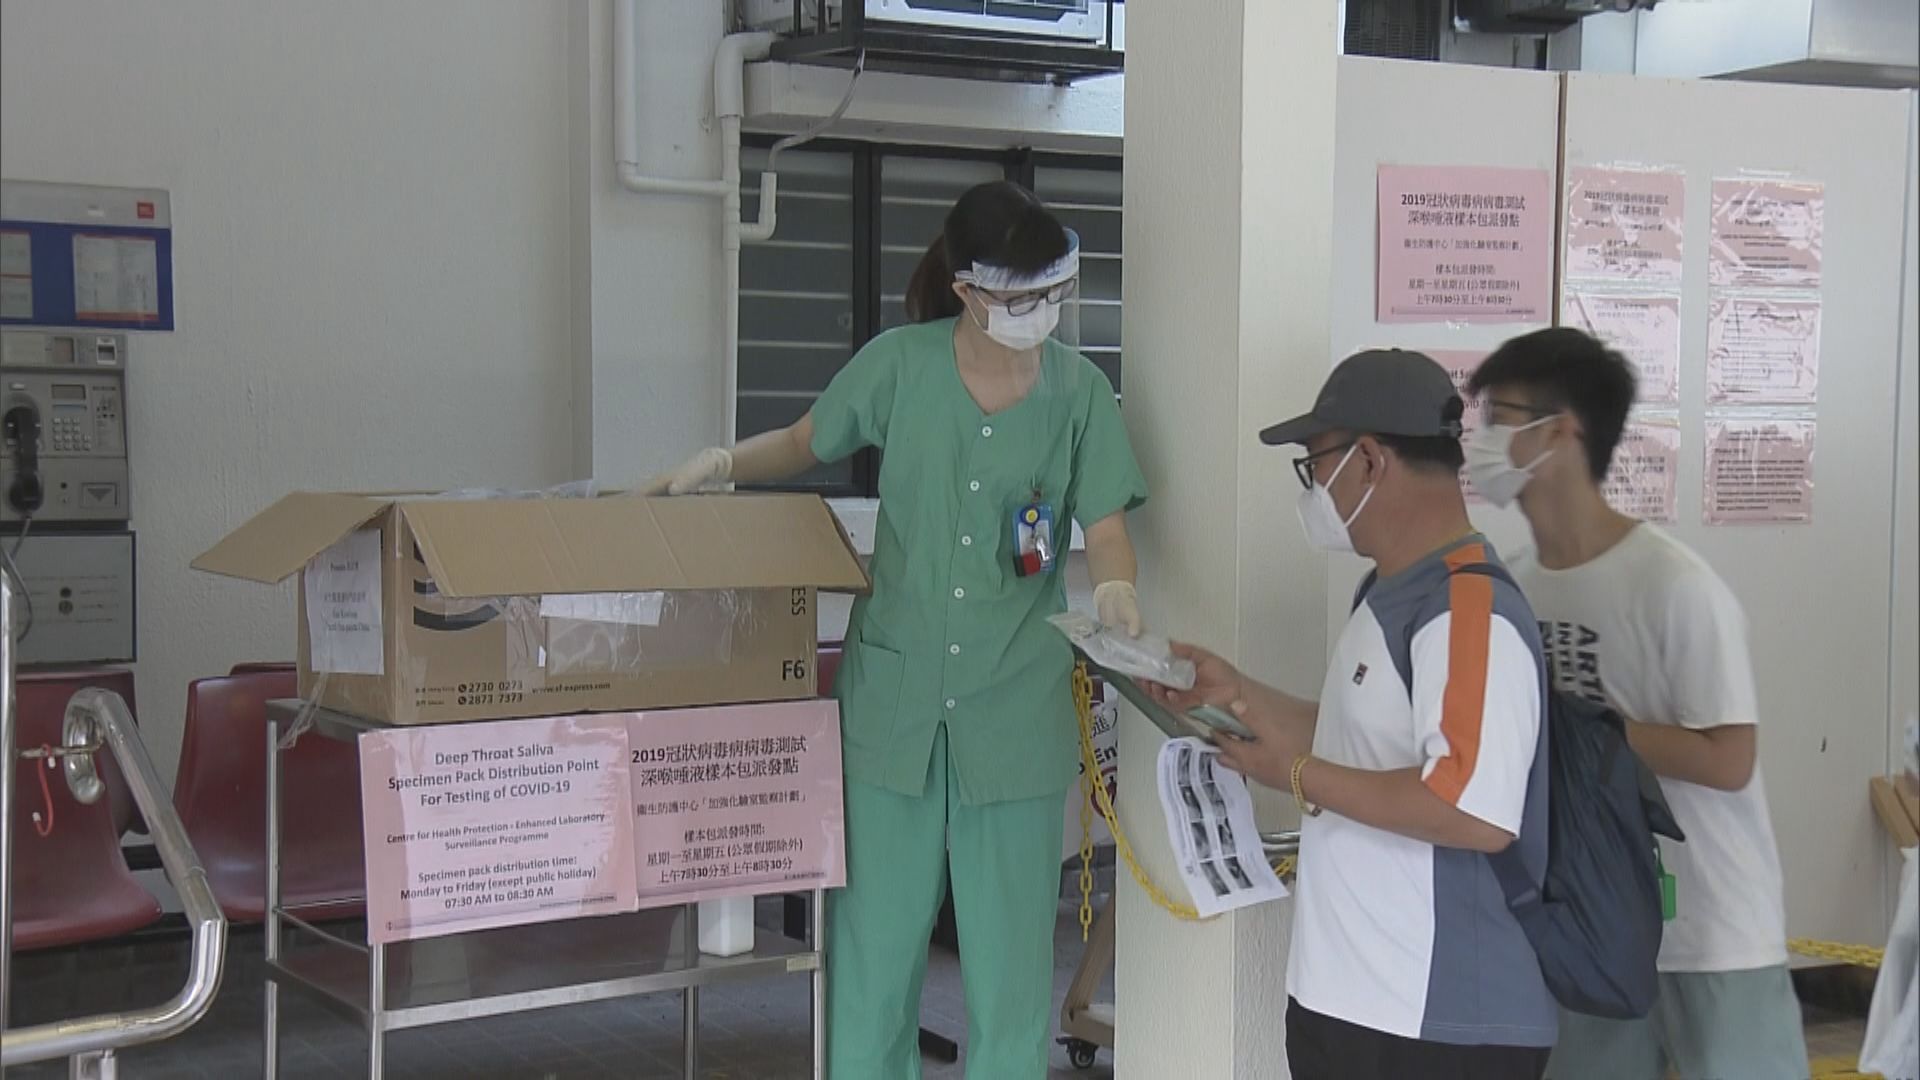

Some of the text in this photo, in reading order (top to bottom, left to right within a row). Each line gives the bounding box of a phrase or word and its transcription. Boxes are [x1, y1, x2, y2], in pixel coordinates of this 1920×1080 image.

[782, 660, 805, 681] F6
[468, 681, 494, 693] 2730
[498, 679, 523, 692] 0273
[468, 693, 523, 705] 2873 7373
[435, 743, 554, 766] Deep Throat Saliva
[632, 735, 807, 763] 2019冠狀病毒病病毒測試
[388, 758, 600, 791] Specimen Pack Distribution Point
[641, 757, 799, 787] 深喉唾液樣本包派發點
[420, 780, 571, 806] For Testing of COVID-19
[386, 831, 414, 843] Centre
[417, 829, 430, 841] for
[432, 827, 461, 839] Health
[463, 823, 508, 835] Protection
[515, 817, 557, 829] Enhanced
[558, 813, 605, 827] Laboratory
[445, 832, 549, 851] Surveillance Programme
[418, 855, 577, 883] Specimen pack distribution time:
[400, 866, 597, 900] Monday to Friday (except public holiday)
[445, 886, 554, 909] 07:30 AM to 08:30 AM
